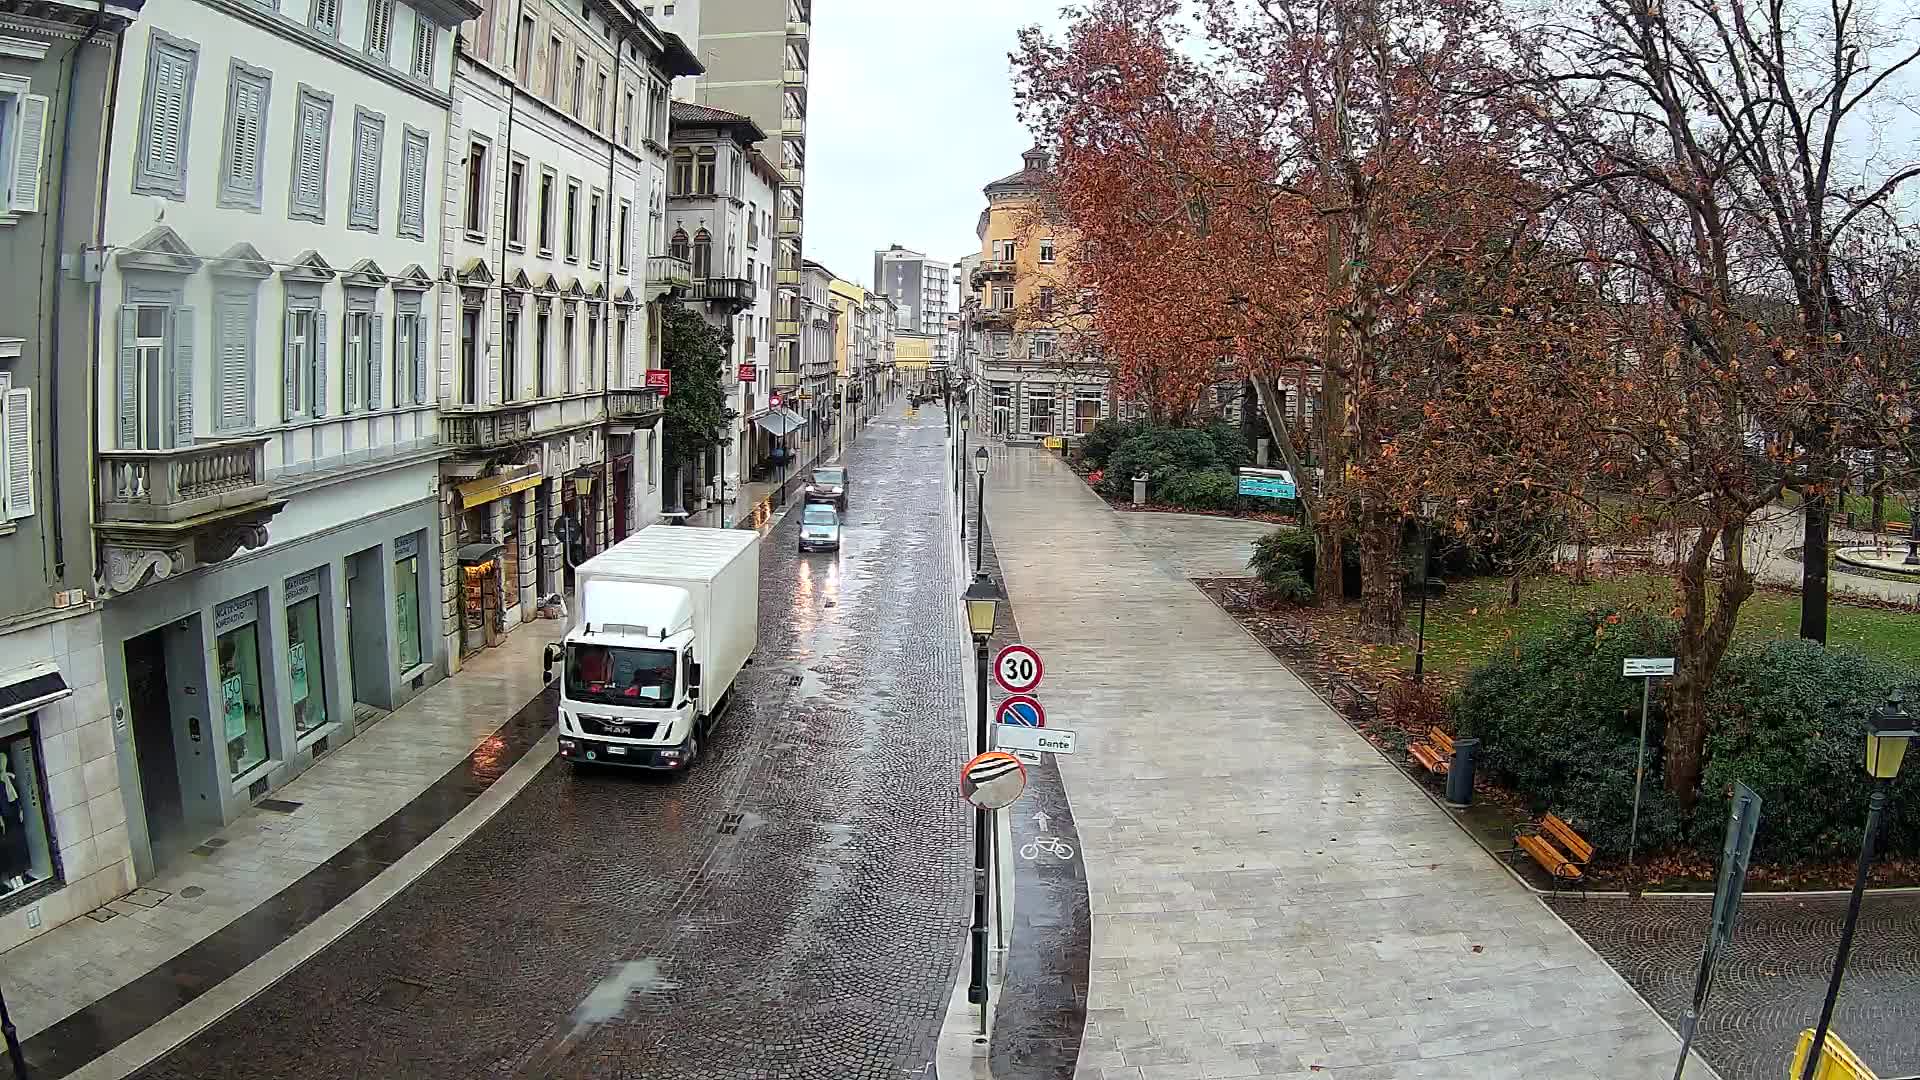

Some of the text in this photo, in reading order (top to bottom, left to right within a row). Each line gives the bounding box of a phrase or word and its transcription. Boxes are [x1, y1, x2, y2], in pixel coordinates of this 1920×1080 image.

[1005, 658, 1033, 681] 30
[223, 678, 240, 700] 130
[1038, 738, 1070, 749] Dante
